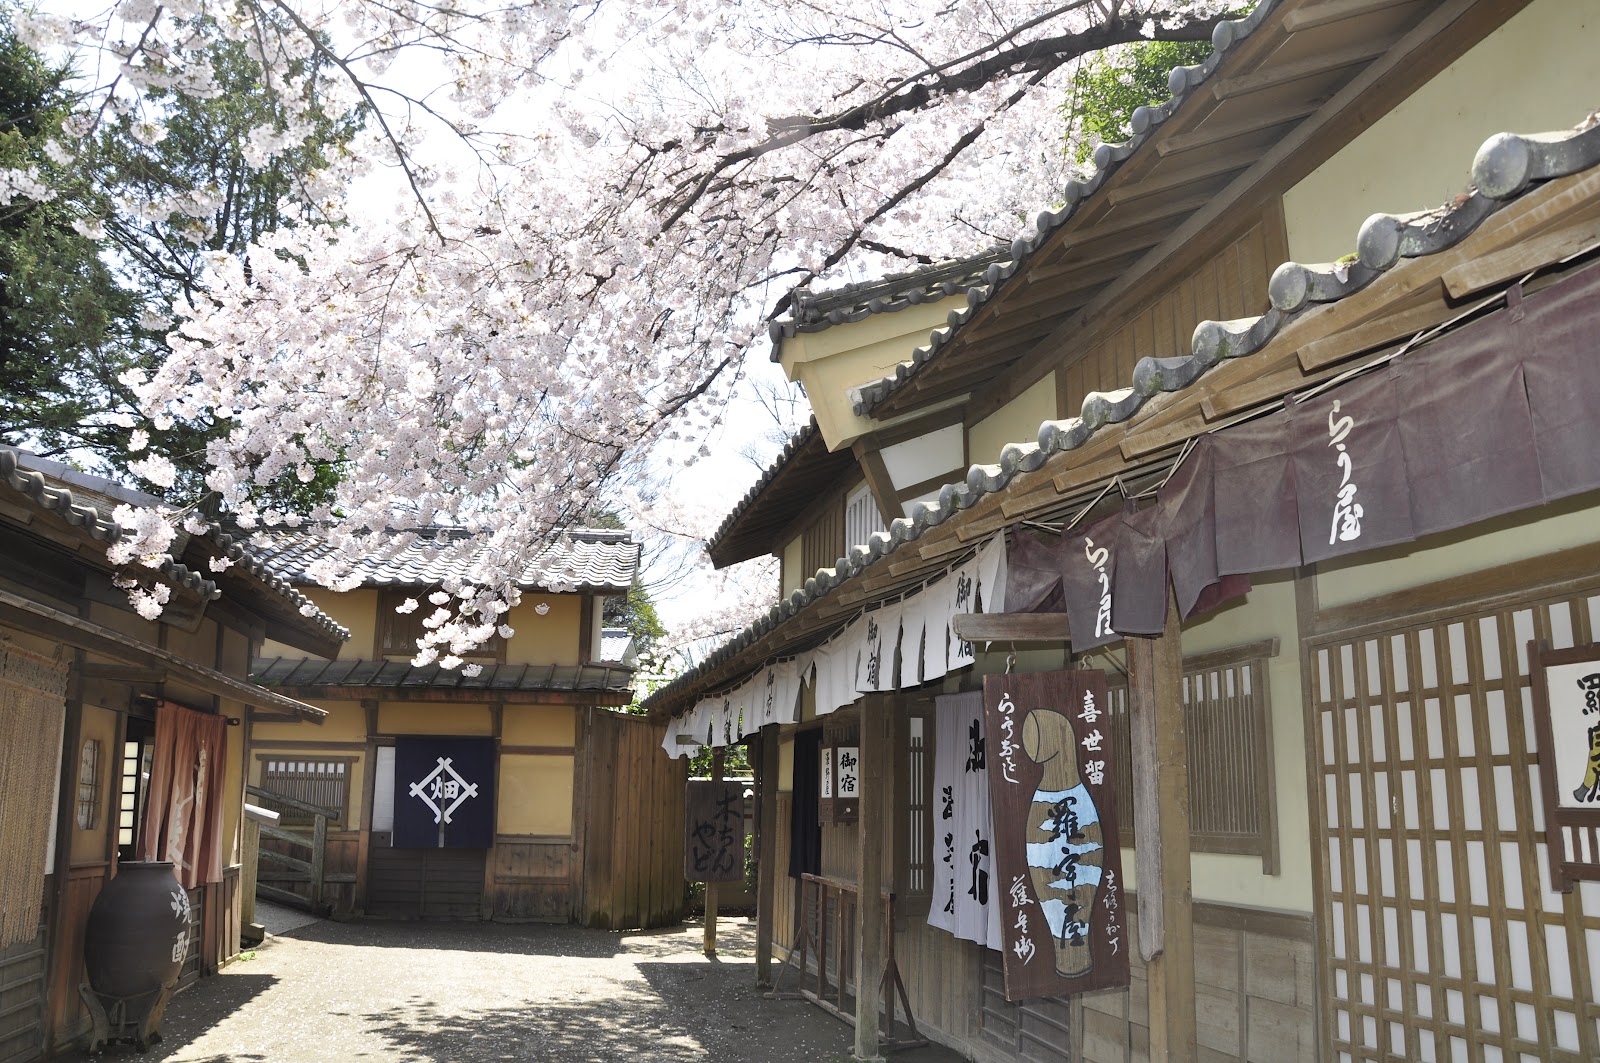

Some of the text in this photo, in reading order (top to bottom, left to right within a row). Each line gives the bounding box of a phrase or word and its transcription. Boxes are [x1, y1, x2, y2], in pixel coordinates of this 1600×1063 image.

[1328, 399, 1364, 545] らう屋
[840, 752, 857, 792] 御宿
[1077, 689, 1105, 785] 喜世留
[430, 776, 460, 800] 畑
[692, 818, 716, 873] やど
[712, 786, 741, 874] 木ちん
